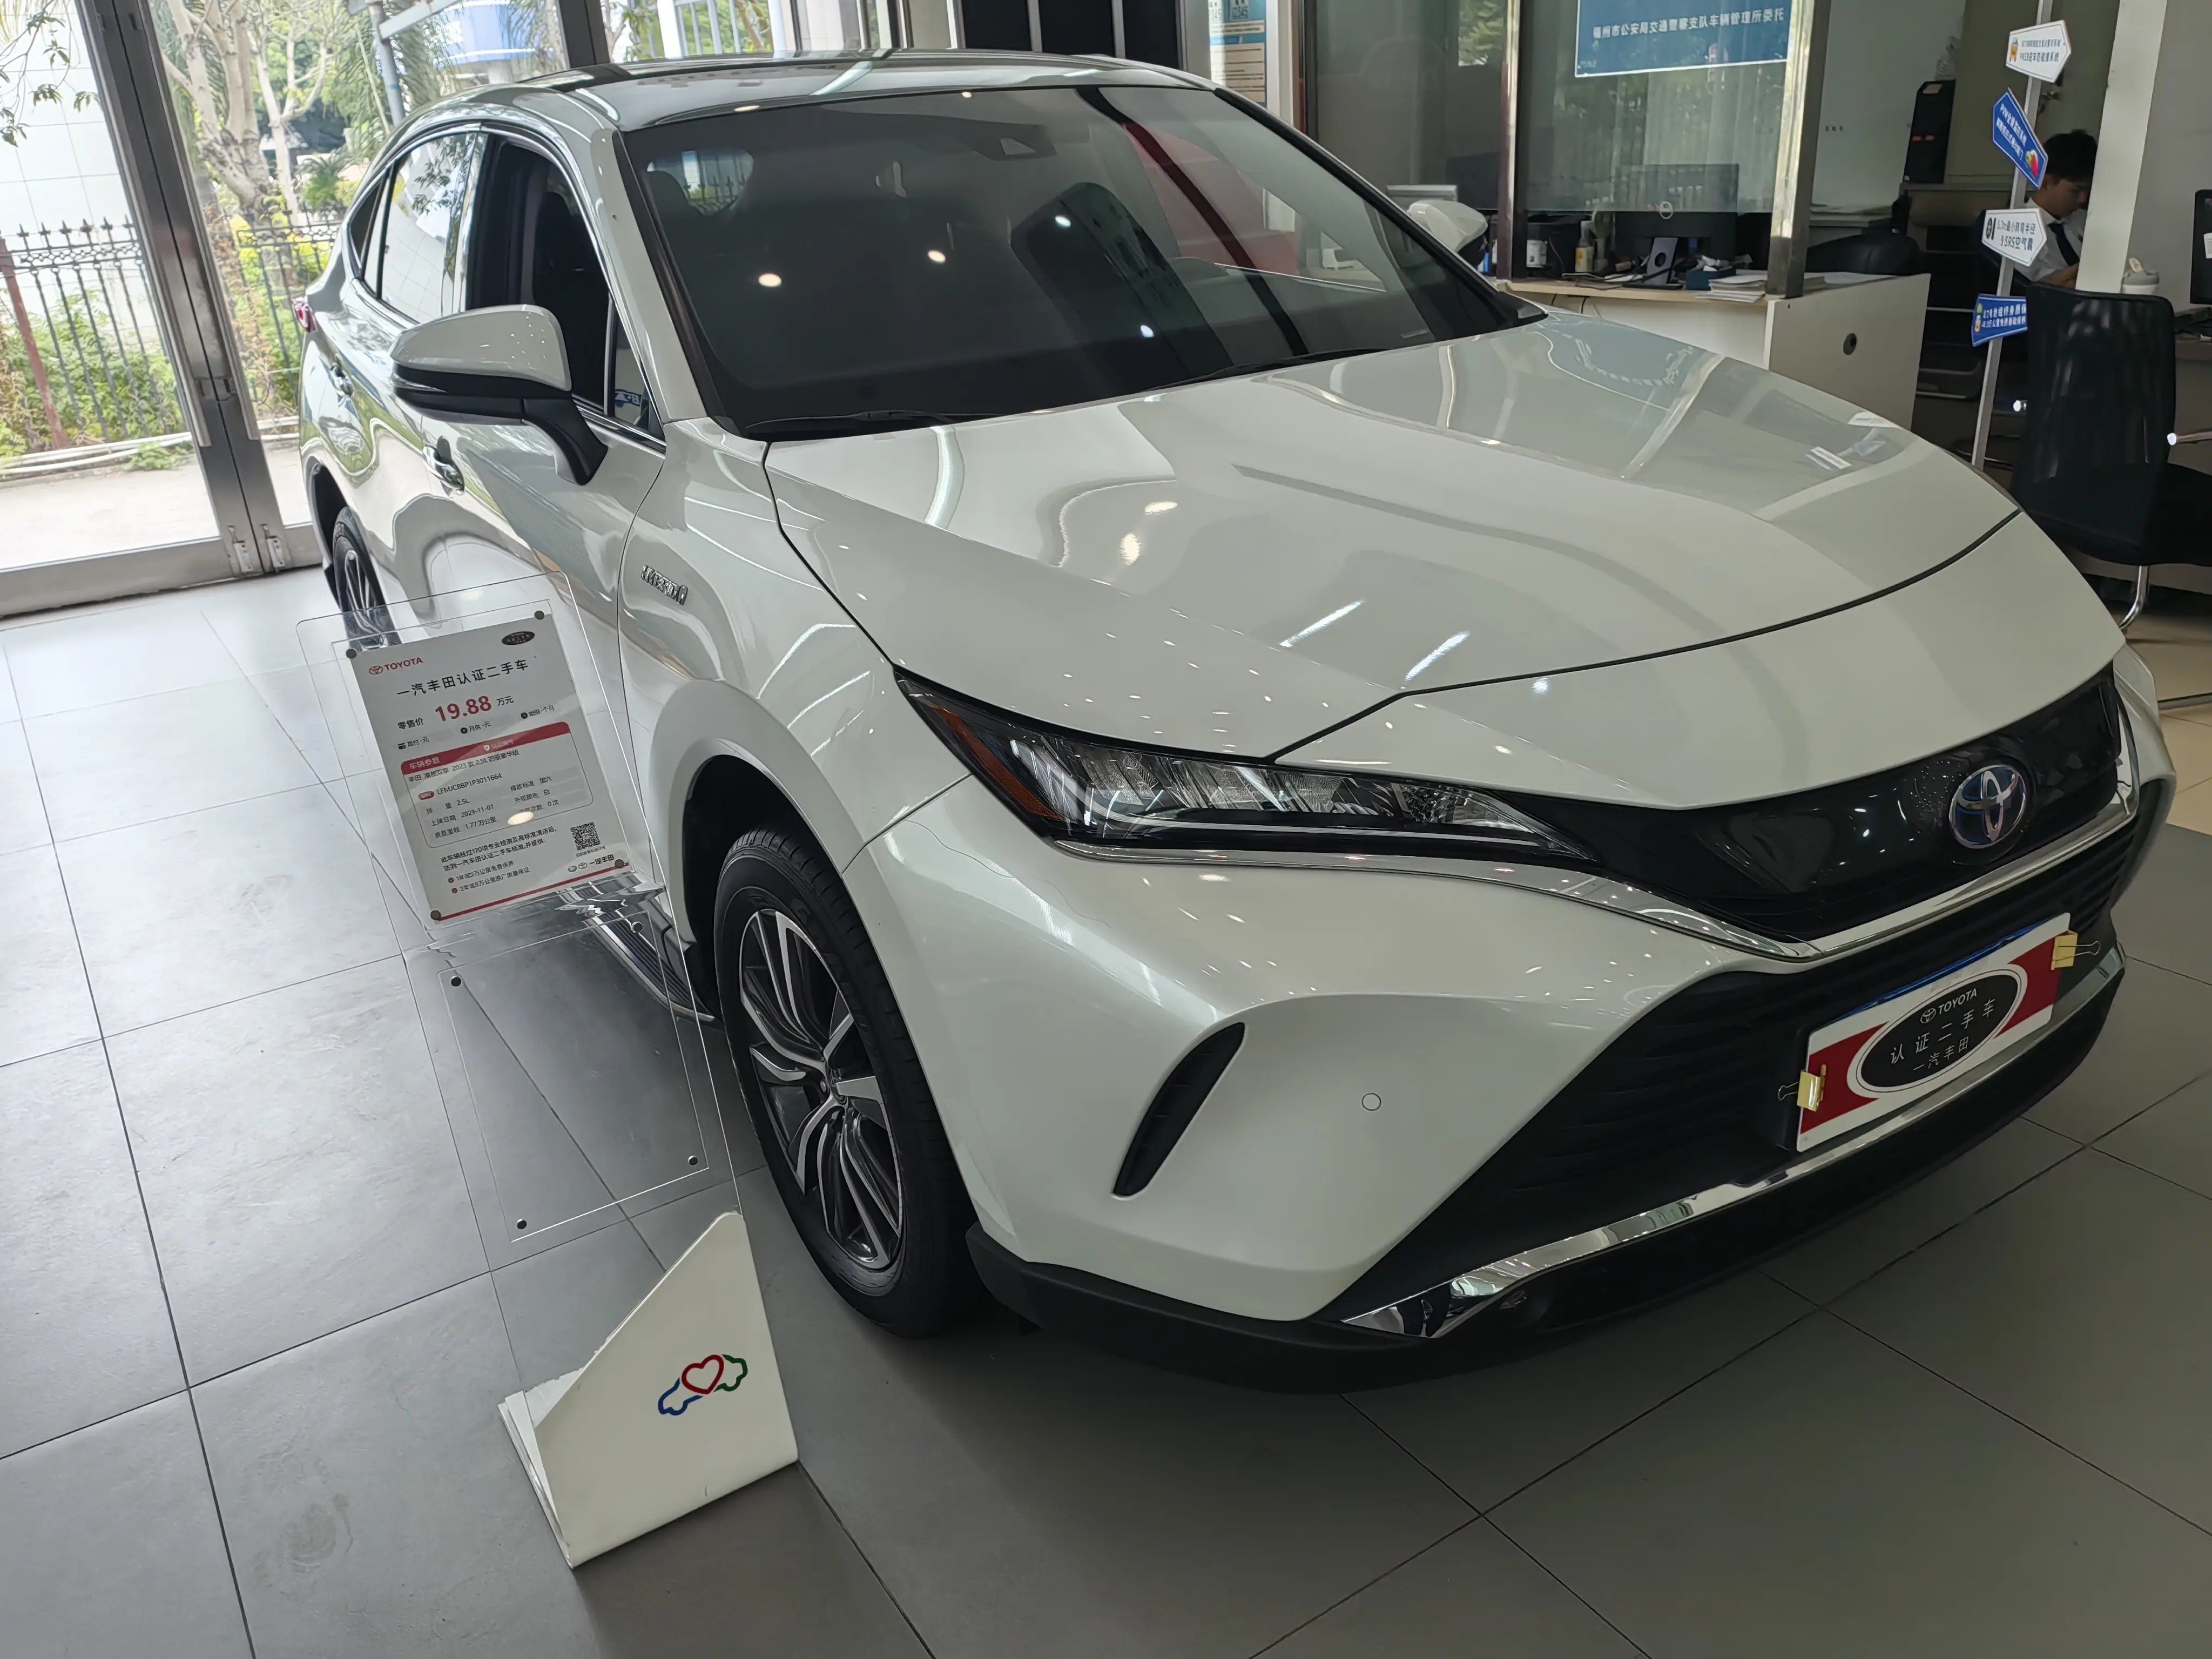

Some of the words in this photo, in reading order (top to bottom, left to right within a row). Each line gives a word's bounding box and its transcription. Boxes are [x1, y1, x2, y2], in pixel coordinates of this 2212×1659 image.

[384, 657, 424, 671] TOYOTA
[397, 659, 529, 696] 一汽丰田认证二手车
[397, 717, 424, 730] 零售价
[434, 694, 493, 722] 19.88
[496, 695, 514, 706] 万元
[451, 762, 467, 771] 2023
[460, 804, 494, 818] 2023-11-07
[1939, 988, 1977, 1014] TOYOTA
[1891, 999, 1995, 1064] 认证二手车
[1913, 1036, 1969, 1071] 一汽丰田
